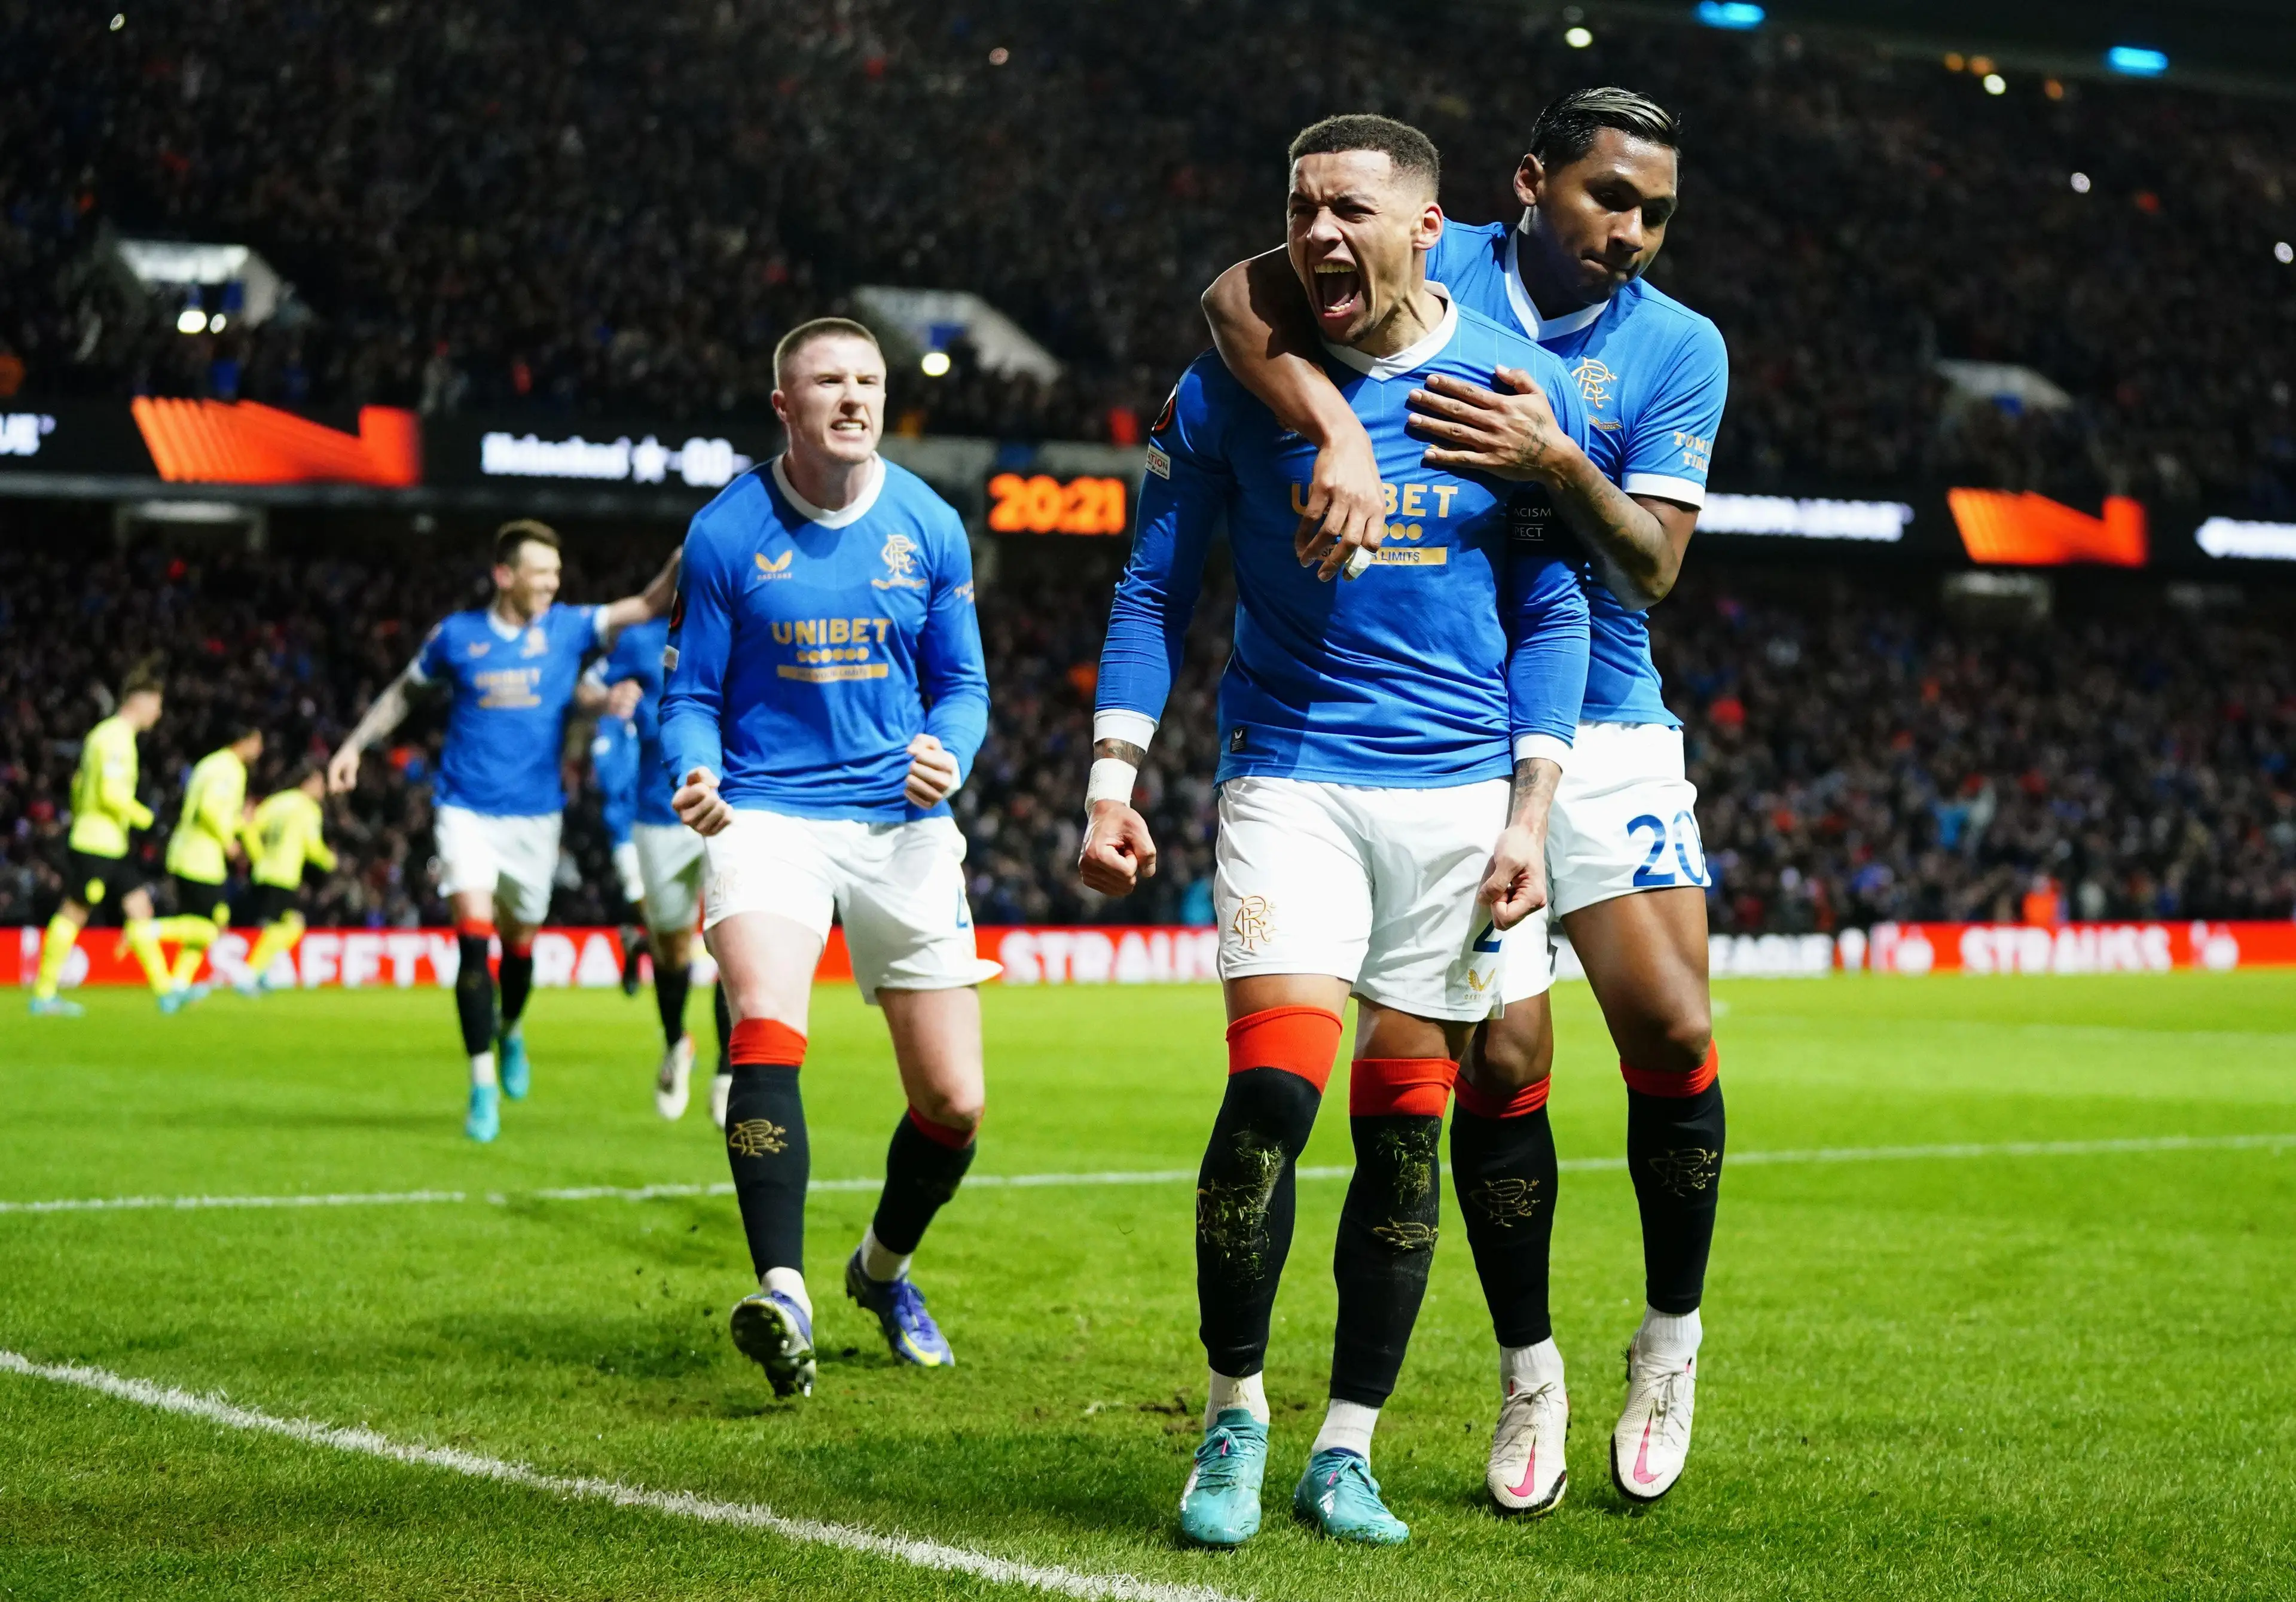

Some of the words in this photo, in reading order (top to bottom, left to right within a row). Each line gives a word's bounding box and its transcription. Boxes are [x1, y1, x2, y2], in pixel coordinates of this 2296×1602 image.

[1292, 483, 1459, 518] UBET
[1514, 508, 1552, 517] ACISM
[1514, 527, 1543, 537] PECT
[1381, 551, 1420, 562] LIMITS
[771, 618, 892, 645] UNIBET
[1626, 810, 1704, 887] 20
[1000, 929, 1220, 987] STRAUS
